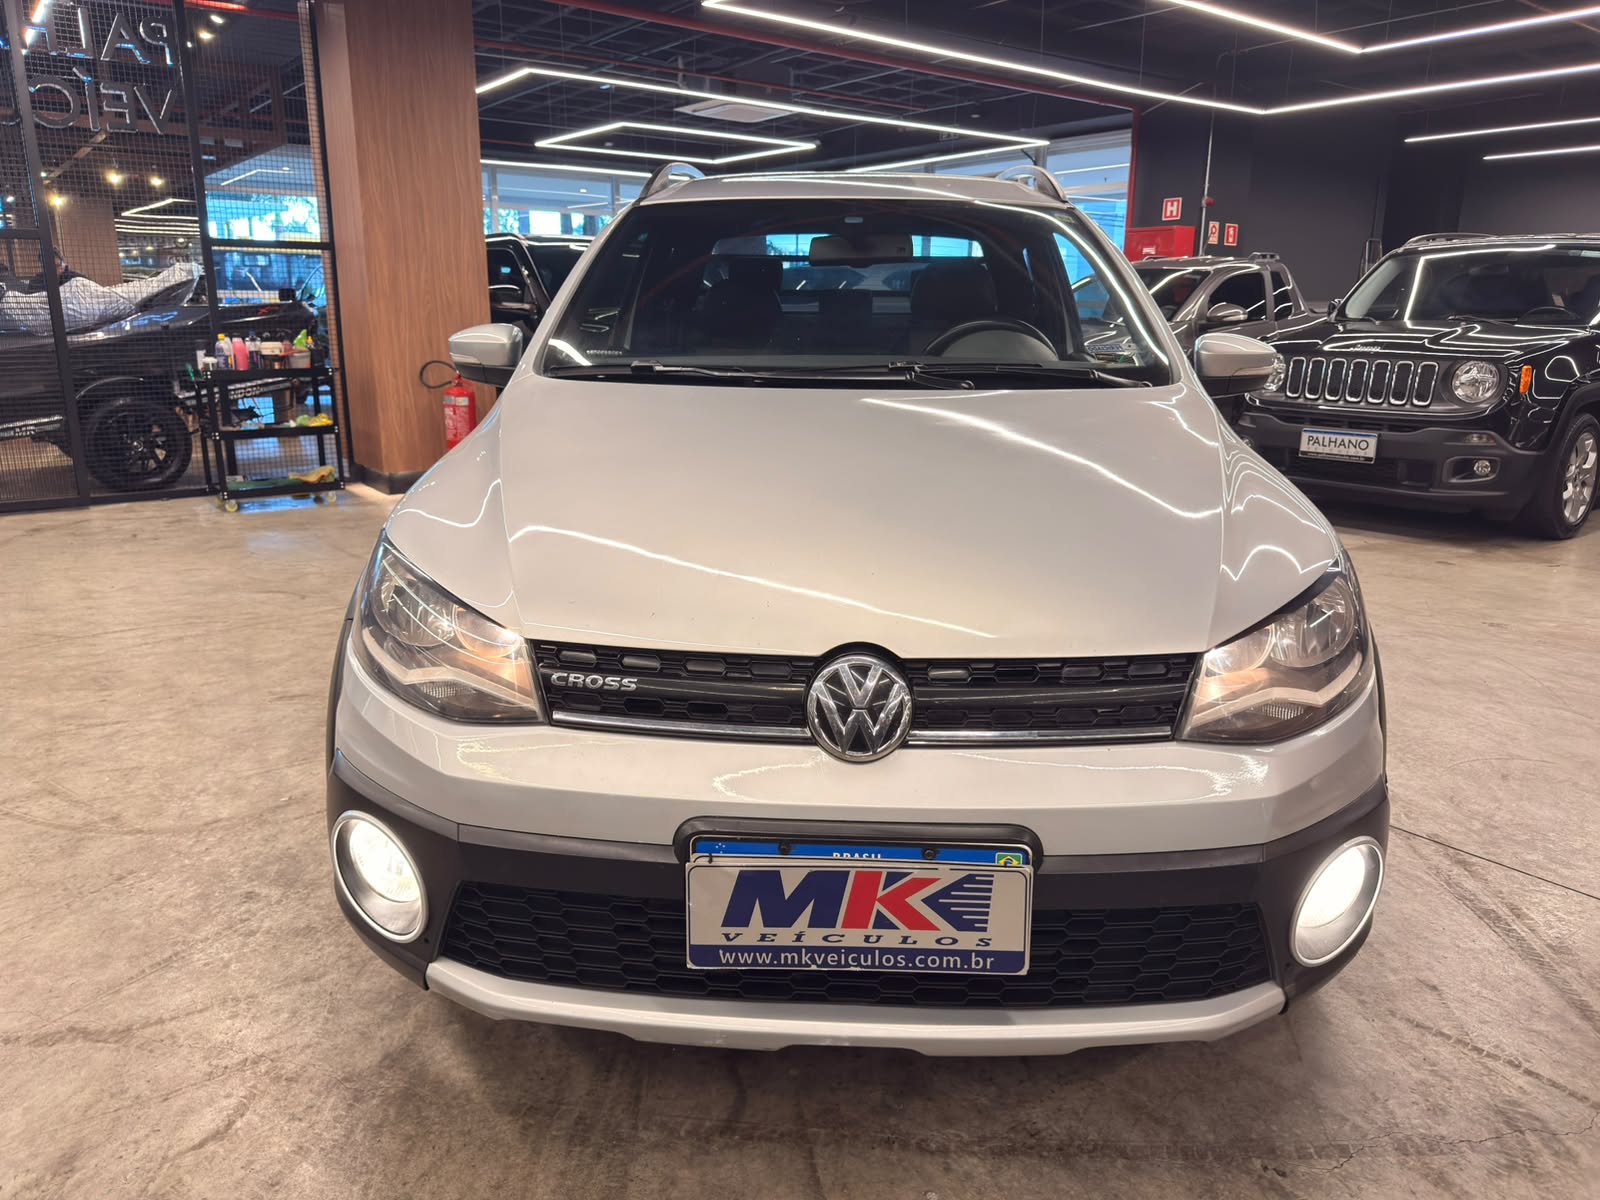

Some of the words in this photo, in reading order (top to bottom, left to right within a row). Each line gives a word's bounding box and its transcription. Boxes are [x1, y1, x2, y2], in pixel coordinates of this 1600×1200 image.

[1166, 201, 1178, 217] H
[1307, 435, 1369, 451] PALHANO
[550, 672, 638, 691] CROSS
[720, 869, 942, 931] MK
[721, 930, 992, 947] VEÍCULOS
[719, 948, 995, 970] www.mkveiculos.com.br
